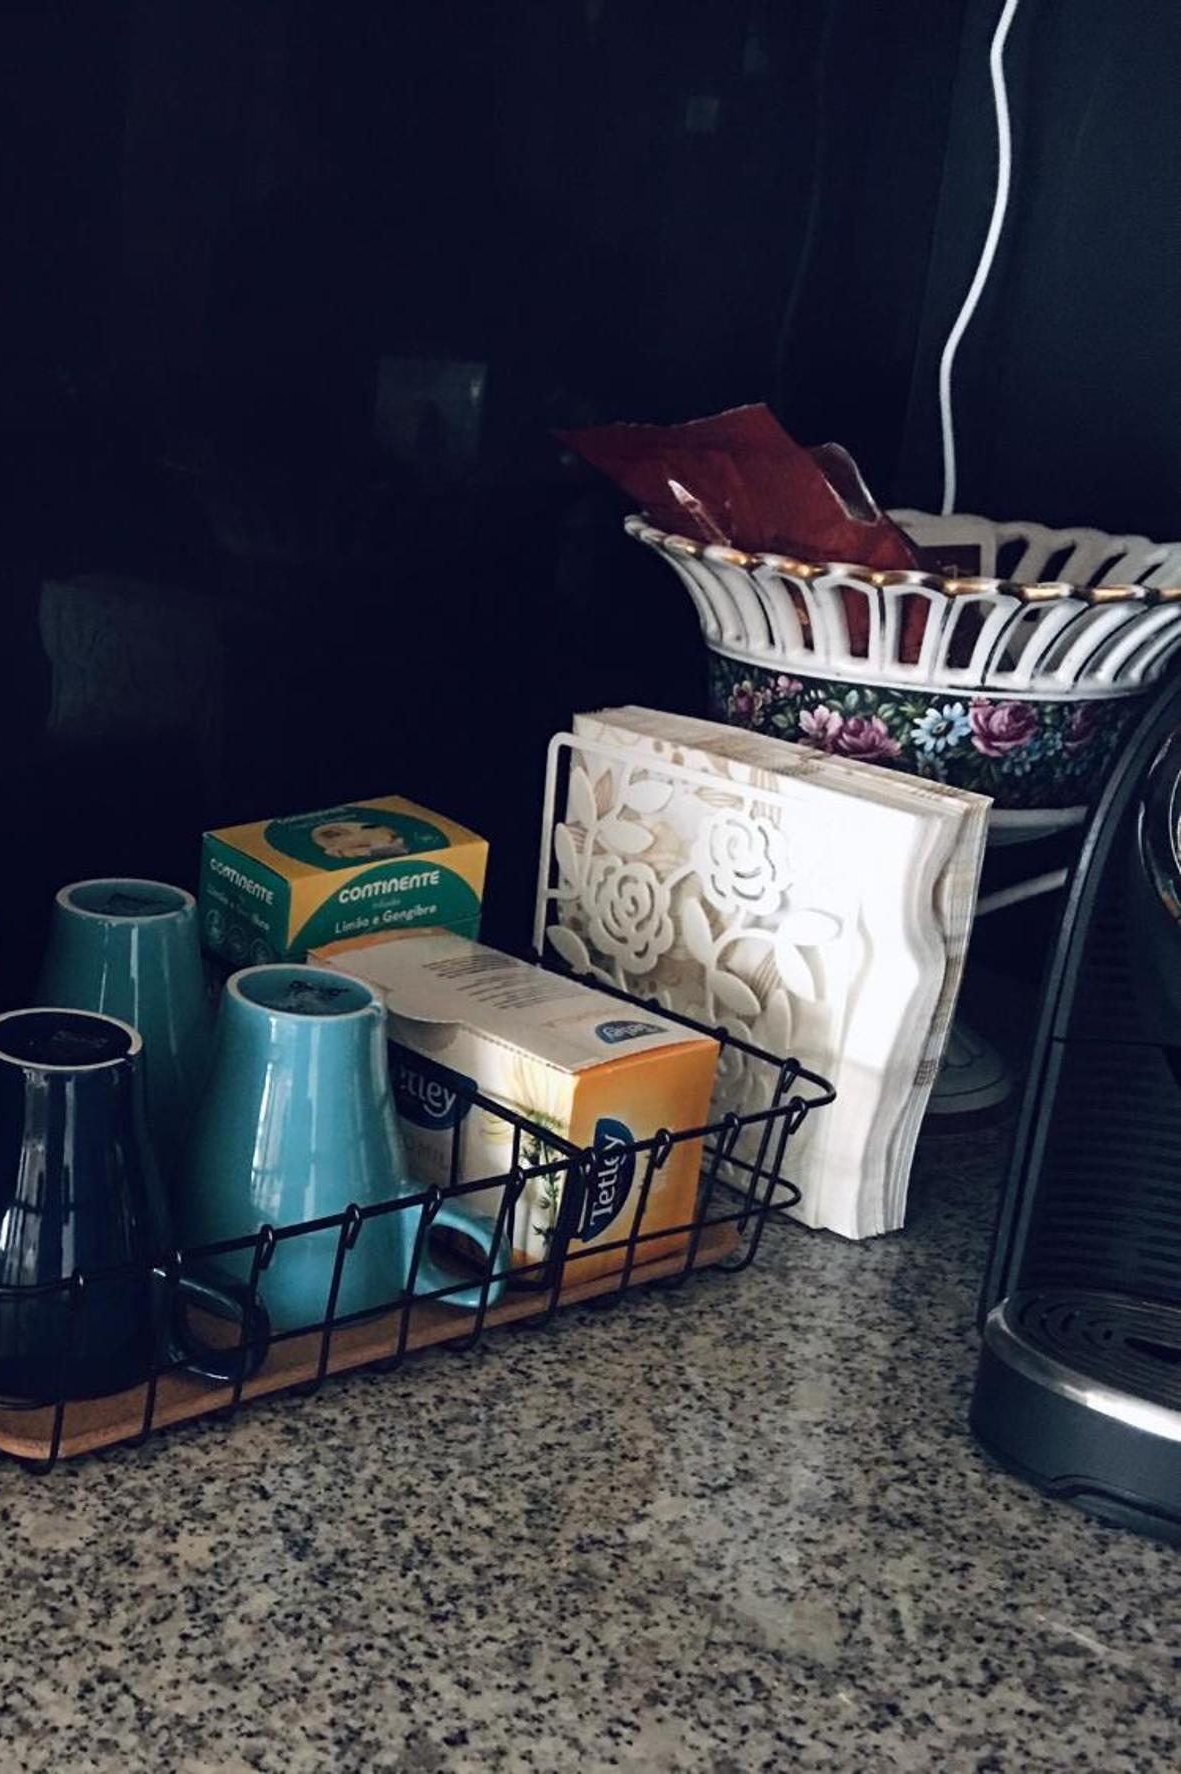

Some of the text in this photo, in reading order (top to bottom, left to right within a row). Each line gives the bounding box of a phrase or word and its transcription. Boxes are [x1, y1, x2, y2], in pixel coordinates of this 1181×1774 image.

[334, 915, 370, 934] Limão
[372, 915, 380, 926] e
[382, 903, 438, 923] Gengibre
[400, 1068, 457, 1118] tley
[589, 1133, 626, 1226] Tetley
